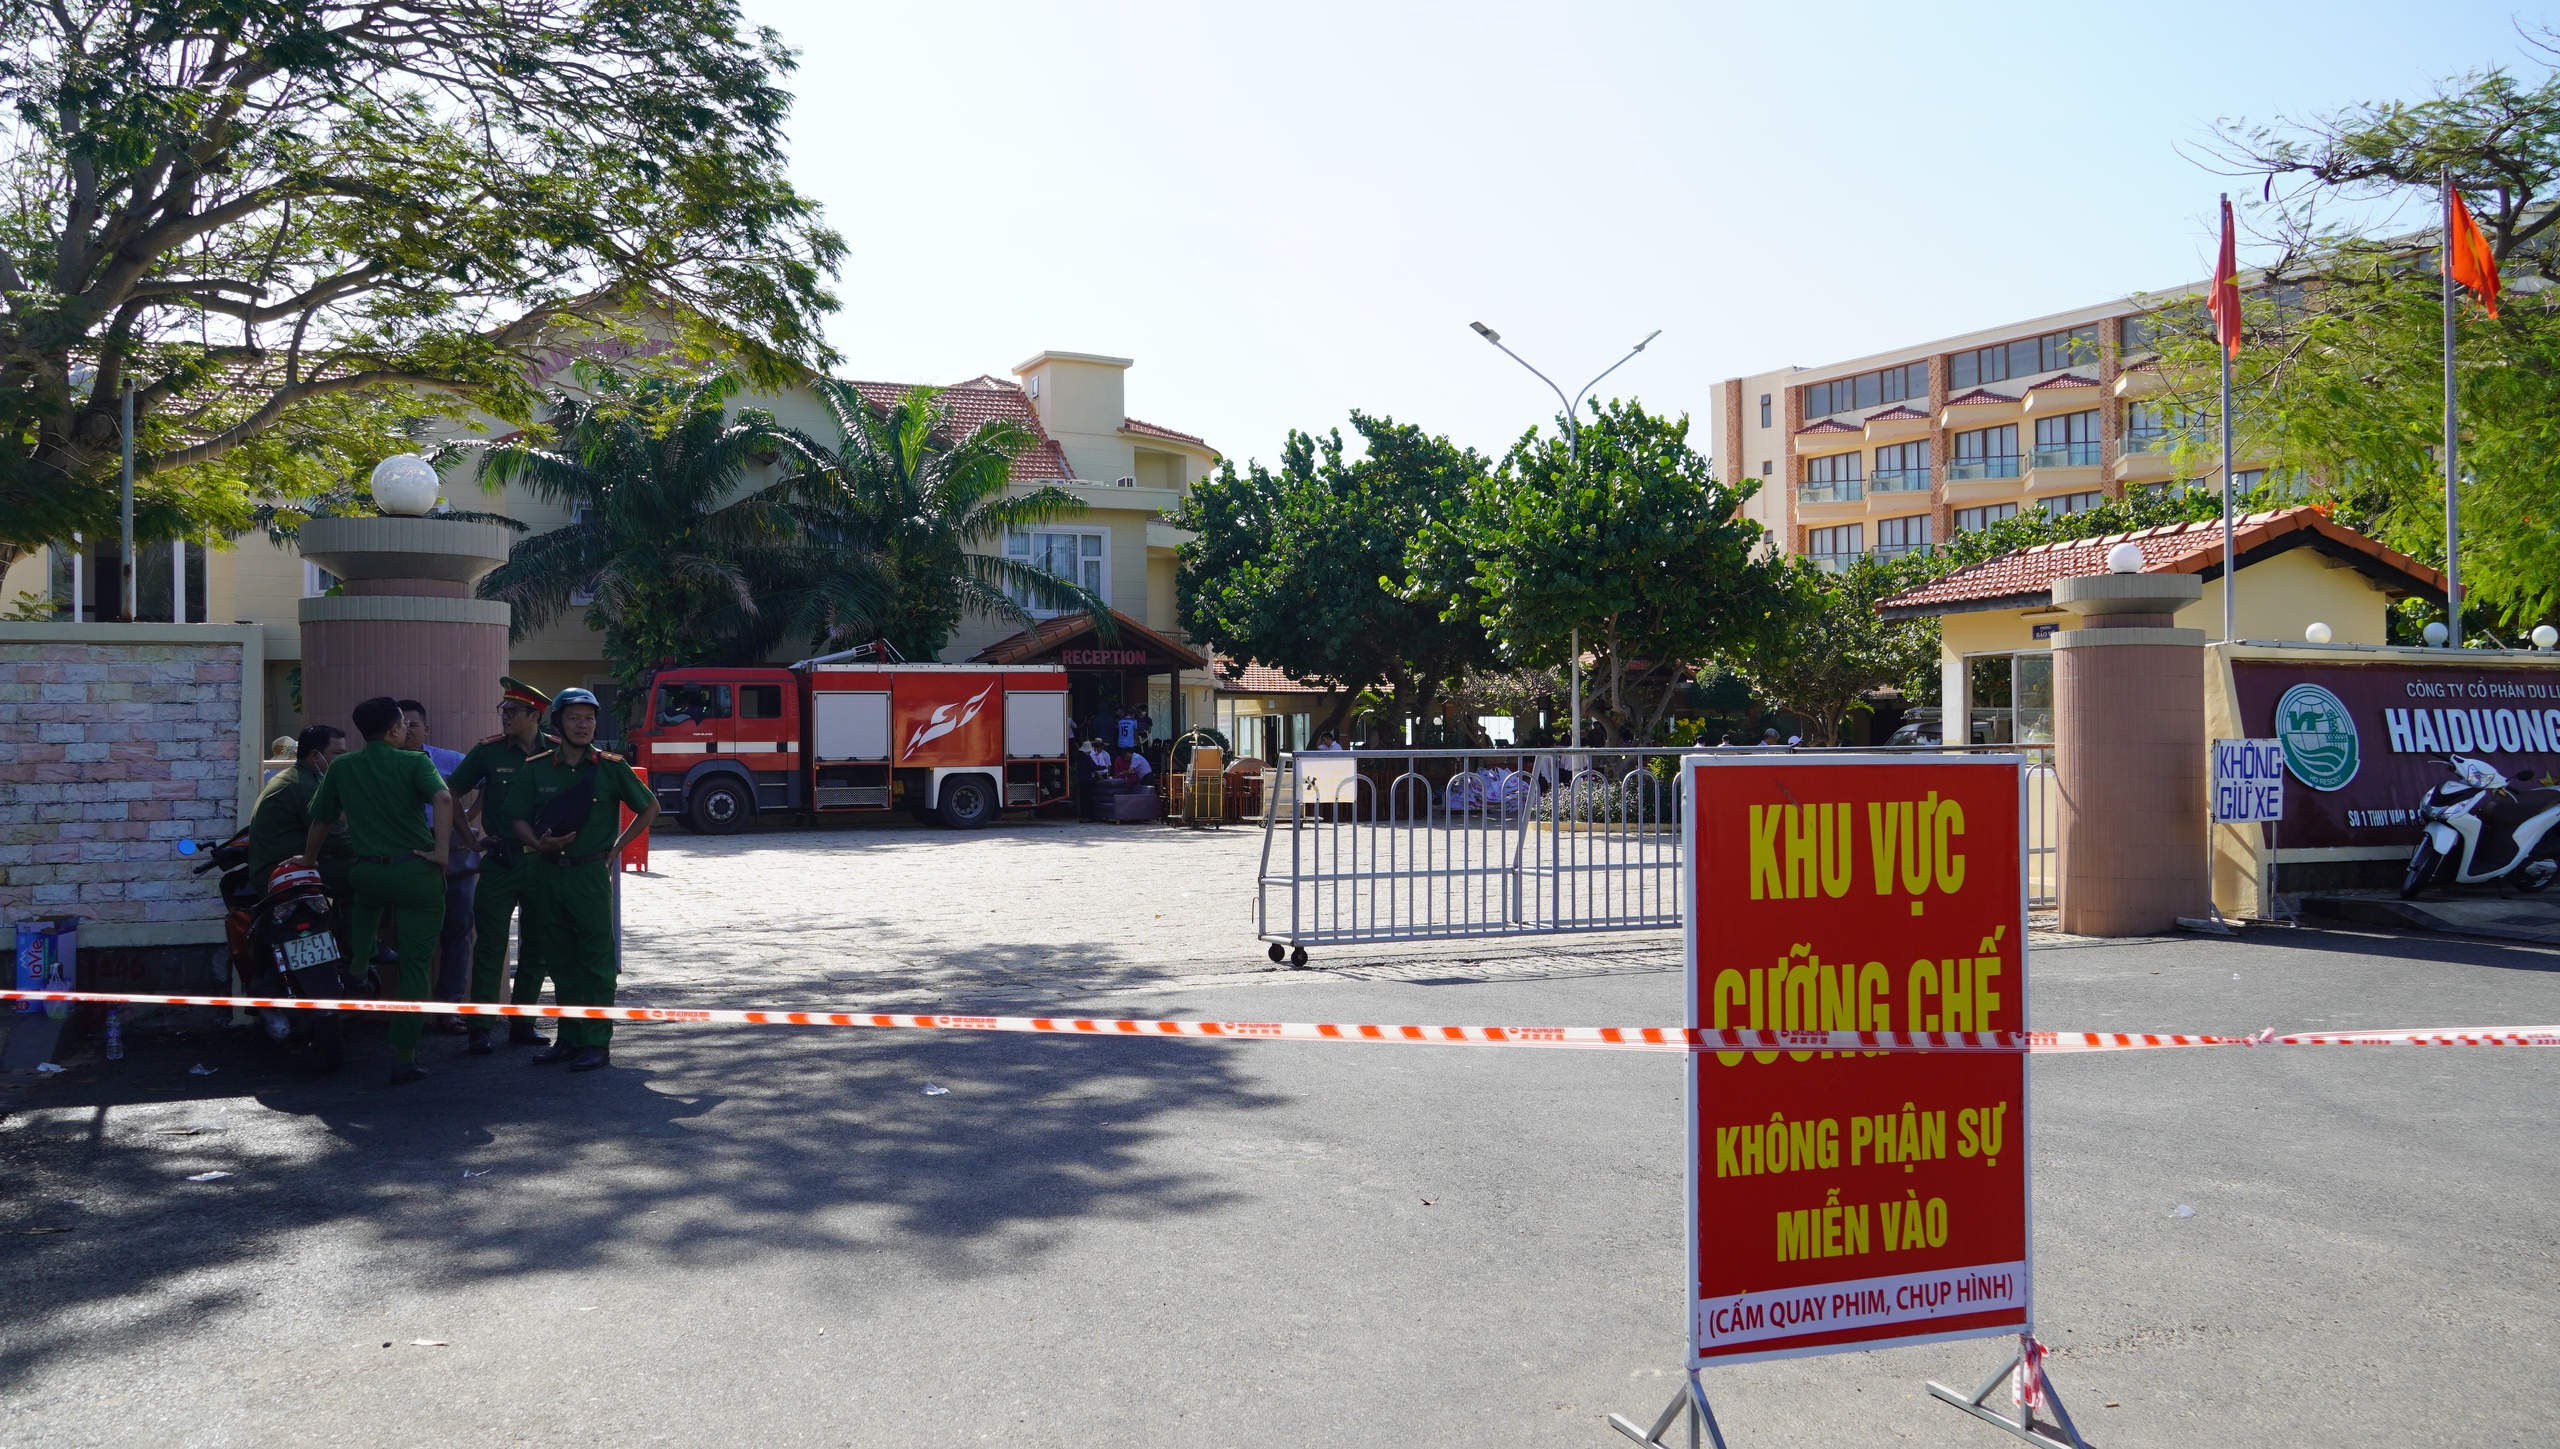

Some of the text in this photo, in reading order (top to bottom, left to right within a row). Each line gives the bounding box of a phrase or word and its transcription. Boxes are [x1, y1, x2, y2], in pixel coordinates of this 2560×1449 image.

[1062, 650, 1147, 665] RECEPTION
[2406, 679, 2445, 698] CÔNG
[2447, 684, 2463, 697] TY
[2467, 676, 2487, 698] CỔ
[2527, 685, 2546, 699] DU
[1120, 726, 1129, 737] 15
[2385, 708, 2560, 753] HAIDUONG
[2220, 740, 2282, 779] KHÔNG
[2309, 774, 2342, 785] HD RESORT
[2254, 786, 2279, 819] XE
[2361, 810, 2368, 827] 1
[1749, 790, 1965, 916] KHU VỰC
[291, 946, 334, 968] 543.21
[292, 935, 326, 954] 72-C1
[1713, 925, 2006, 1067] CƯỠNG CHẾ
[1716, 1101, 2007, 1178] KHÔNG PHẬN SỰ
[1777, 1187, 1948, 1262] MIỄN VÀO
[1710, 1298, 1764, 1338] (CẤM
[1769, 1296, 1827, 1330] QUAY
[1832, 1289, 1892, 1319] PHIM,
[1896, 1281, 1951, 1314] CHỤP
[1956, 1273, 2013, 1303] HÌNH)
